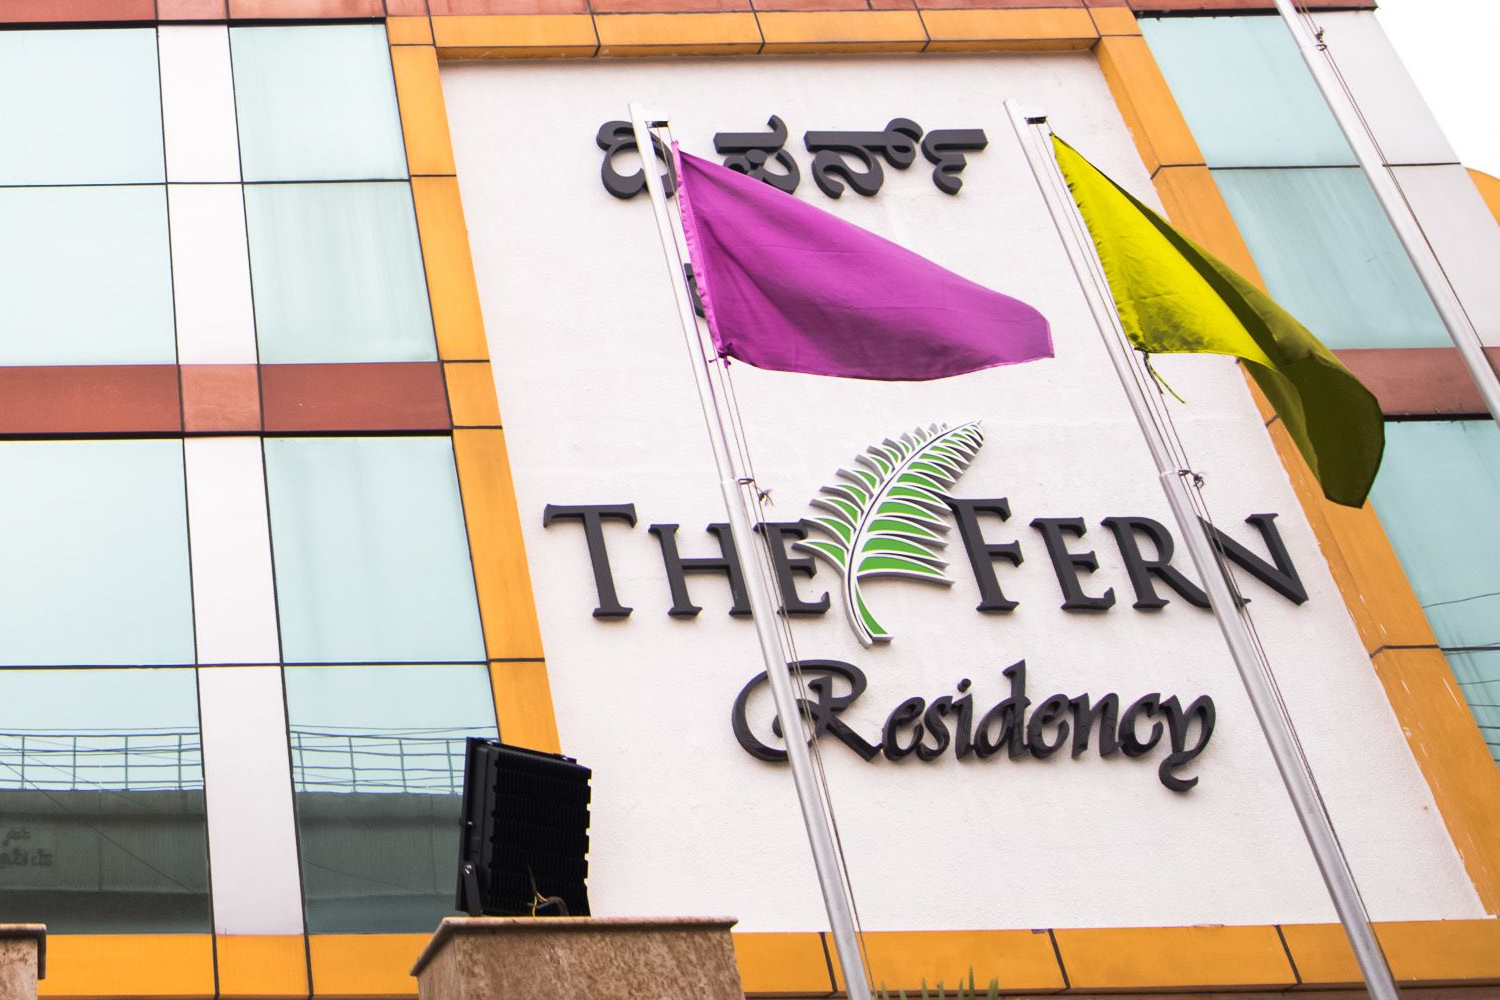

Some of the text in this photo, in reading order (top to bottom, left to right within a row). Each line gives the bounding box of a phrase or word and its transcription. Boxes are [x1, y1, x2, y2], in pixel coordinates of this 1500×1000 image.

[543, 496, 1310, 616] THE FERN
[731, 659, 1217, 793] Residency
